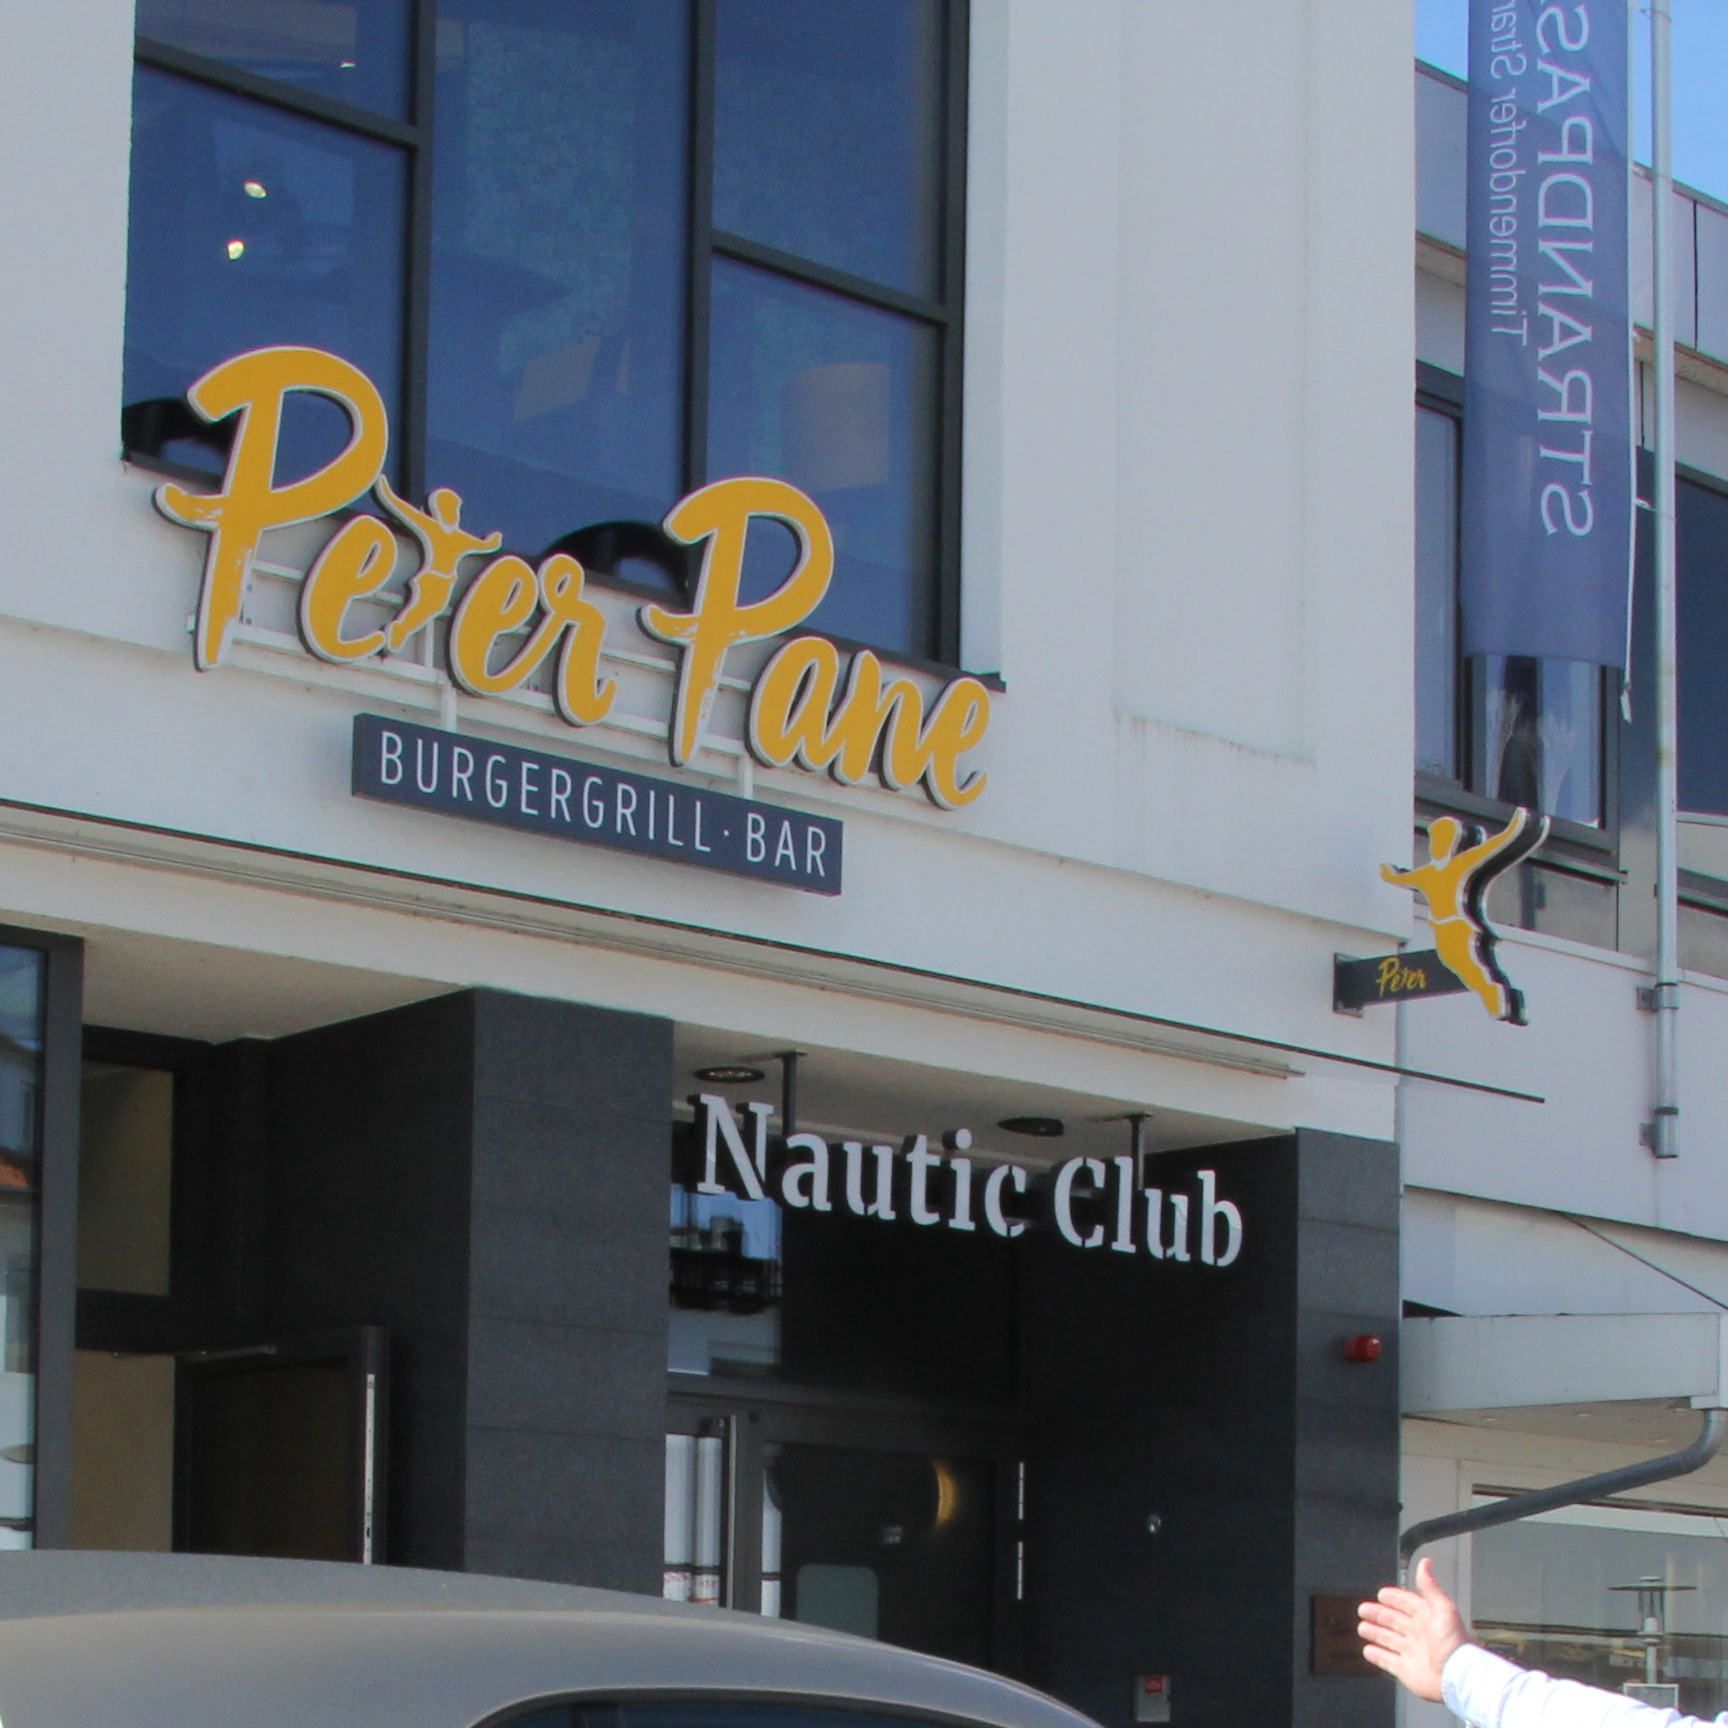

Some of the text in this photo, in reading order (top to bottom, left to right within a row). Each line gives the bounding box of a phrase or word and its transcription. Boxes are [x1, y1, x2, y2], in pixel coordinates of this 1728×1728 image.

[153, 345, 994, 811] Peter Pane
[379, 729, 829, 878] BURGERGRILL BAR
[1376, 956, 1427, 998] Peter
[695, 1092, 1244, 1268] Nautic Club
